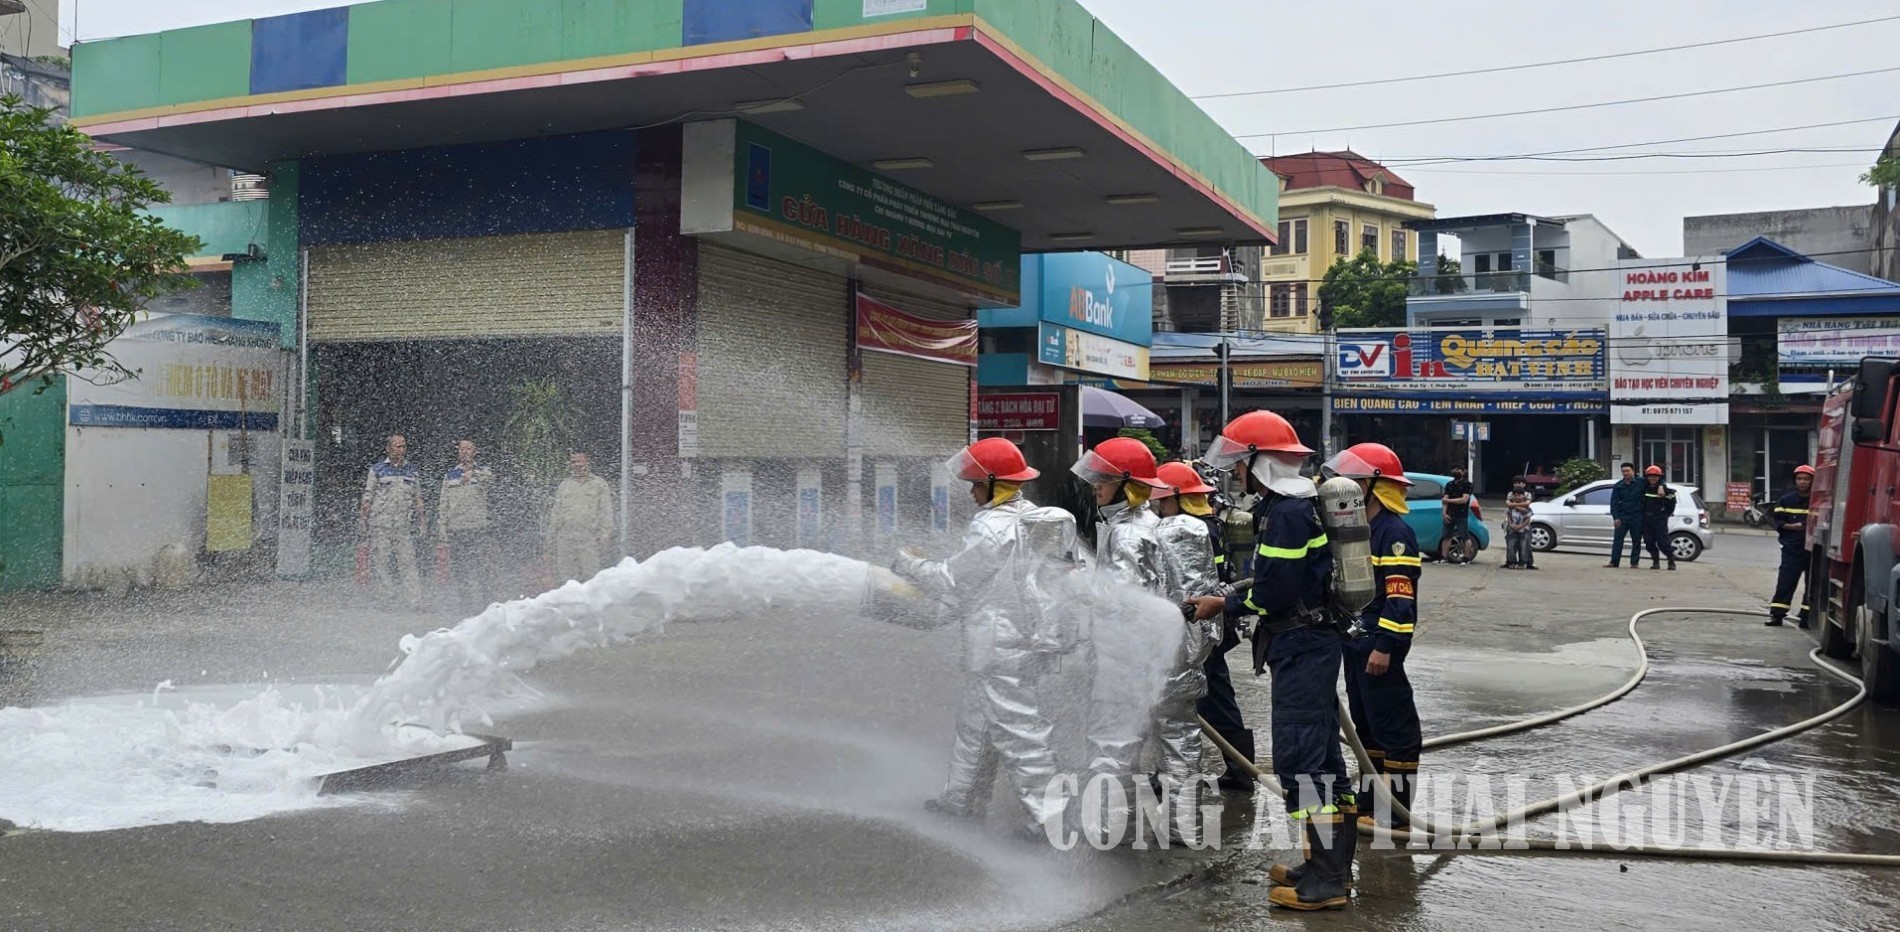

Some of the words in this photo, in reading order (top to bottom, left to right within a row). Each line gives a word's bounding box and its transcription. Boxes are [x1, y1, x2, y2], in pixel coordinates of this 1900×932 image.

[782, 194, 829, 232] CỬA
[835, 213, 890, 251] HÀNG
[896, 233, 944, 268] XĂNG
[1627, 270, 1678, 284] HOÀNG
[1682, 271, 1709, 283] KIM
[1622, 290, 1668, 301] APPLE
[1674, 288, 1713, 300] CARE
[1069, 286, 1113, 329] ABBank
[177, 331, 187, 342] TY
[1526, 361, 1593, 376] VINH
